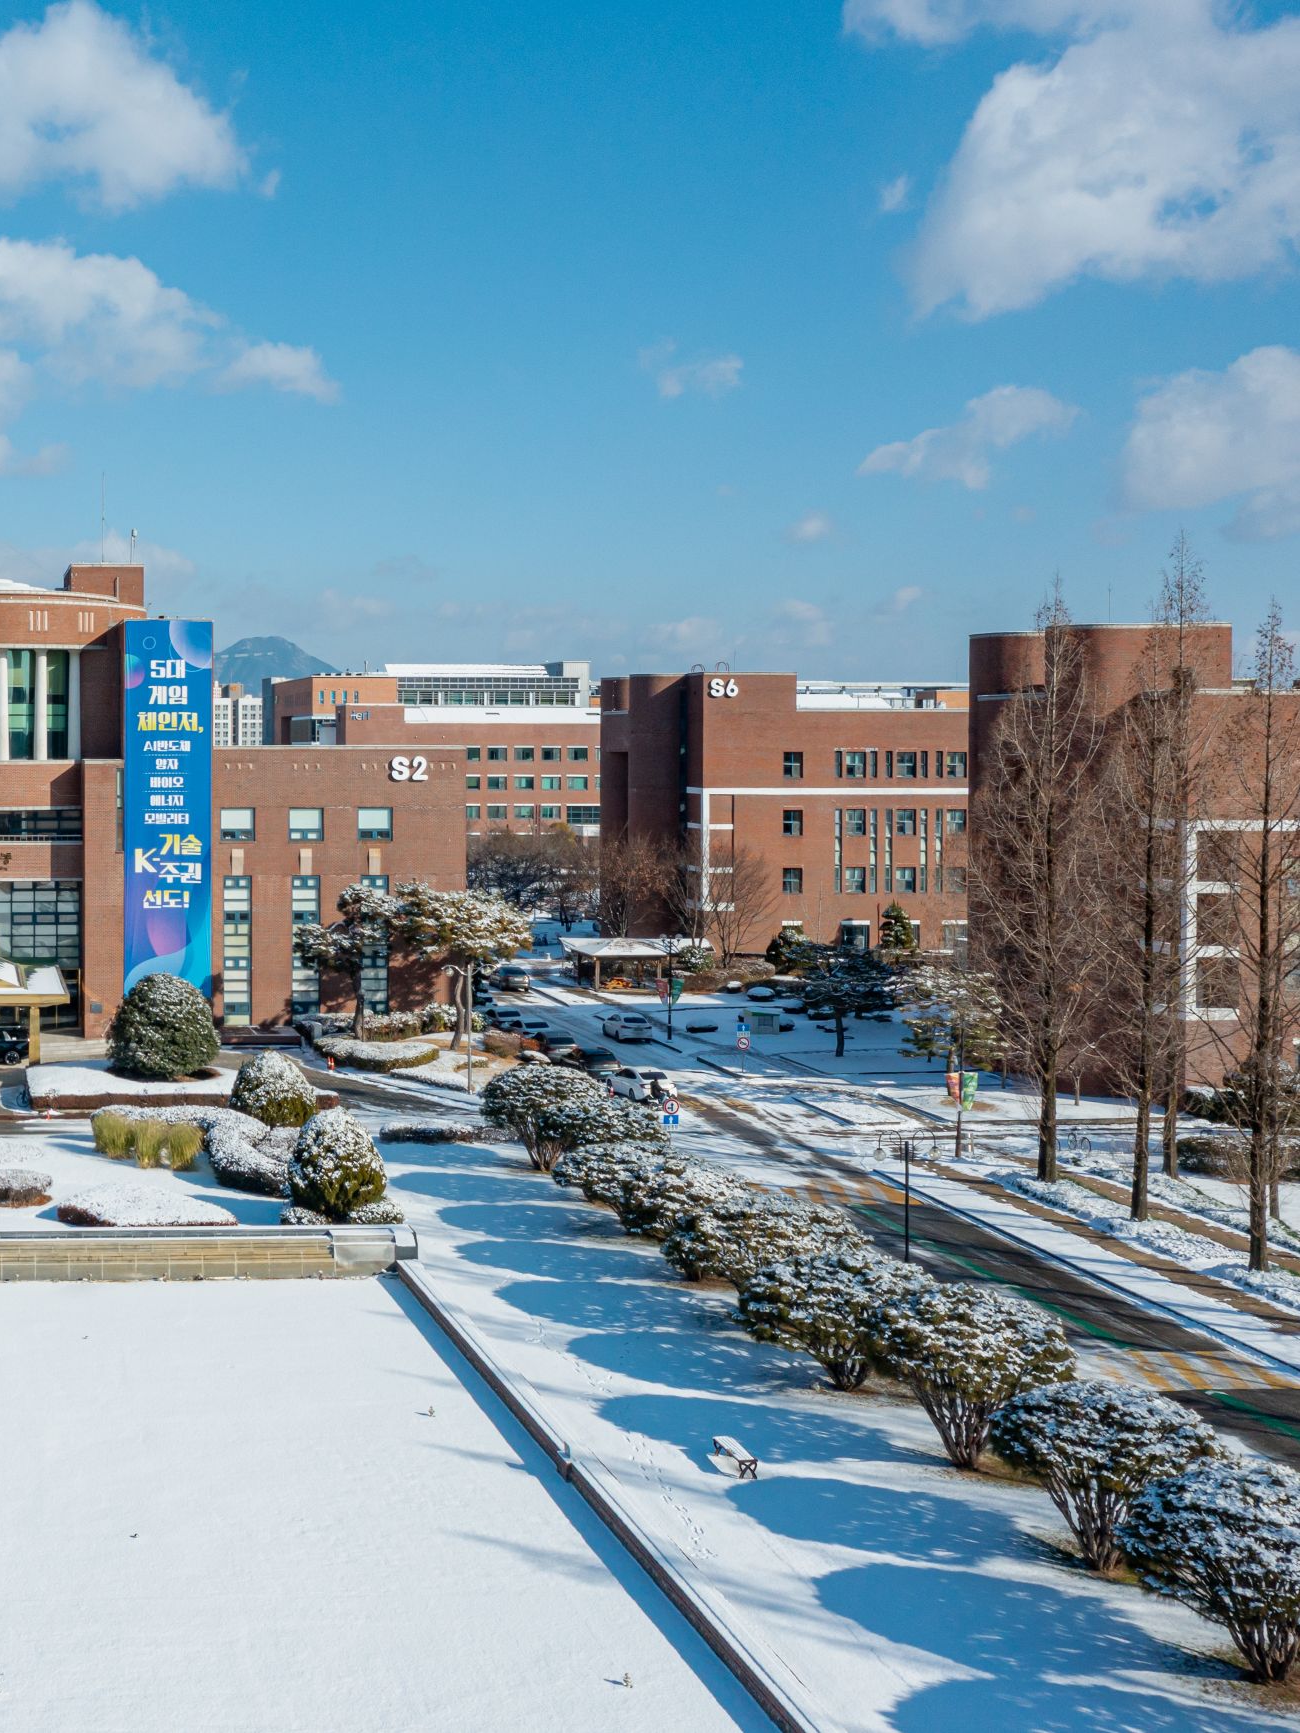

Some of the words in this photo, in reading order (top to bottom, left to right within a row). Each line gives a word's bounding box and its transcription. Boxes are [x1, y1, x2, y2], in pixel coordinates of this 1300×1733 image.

[150, 659, 186, 679] 5대
[148, 685, 188, 705] 게임
[710, 678, 739, 697] S6
[137, 711, 204, 733] 체인저,
[143, 740, 191, 752] AI반도체
[155, 758, 178, 770] 양자
[391, 755, 429, 781] S2
[149, 776, 184, 789] 바이오
[149, 794, 184, 807] 에너지
[143, 813, 190, 825] 모빌리티
[159, 833, 203, 856] 기술
[158, 862, 202, 884] 주권
[143, 890, 190, 909] 선도!
